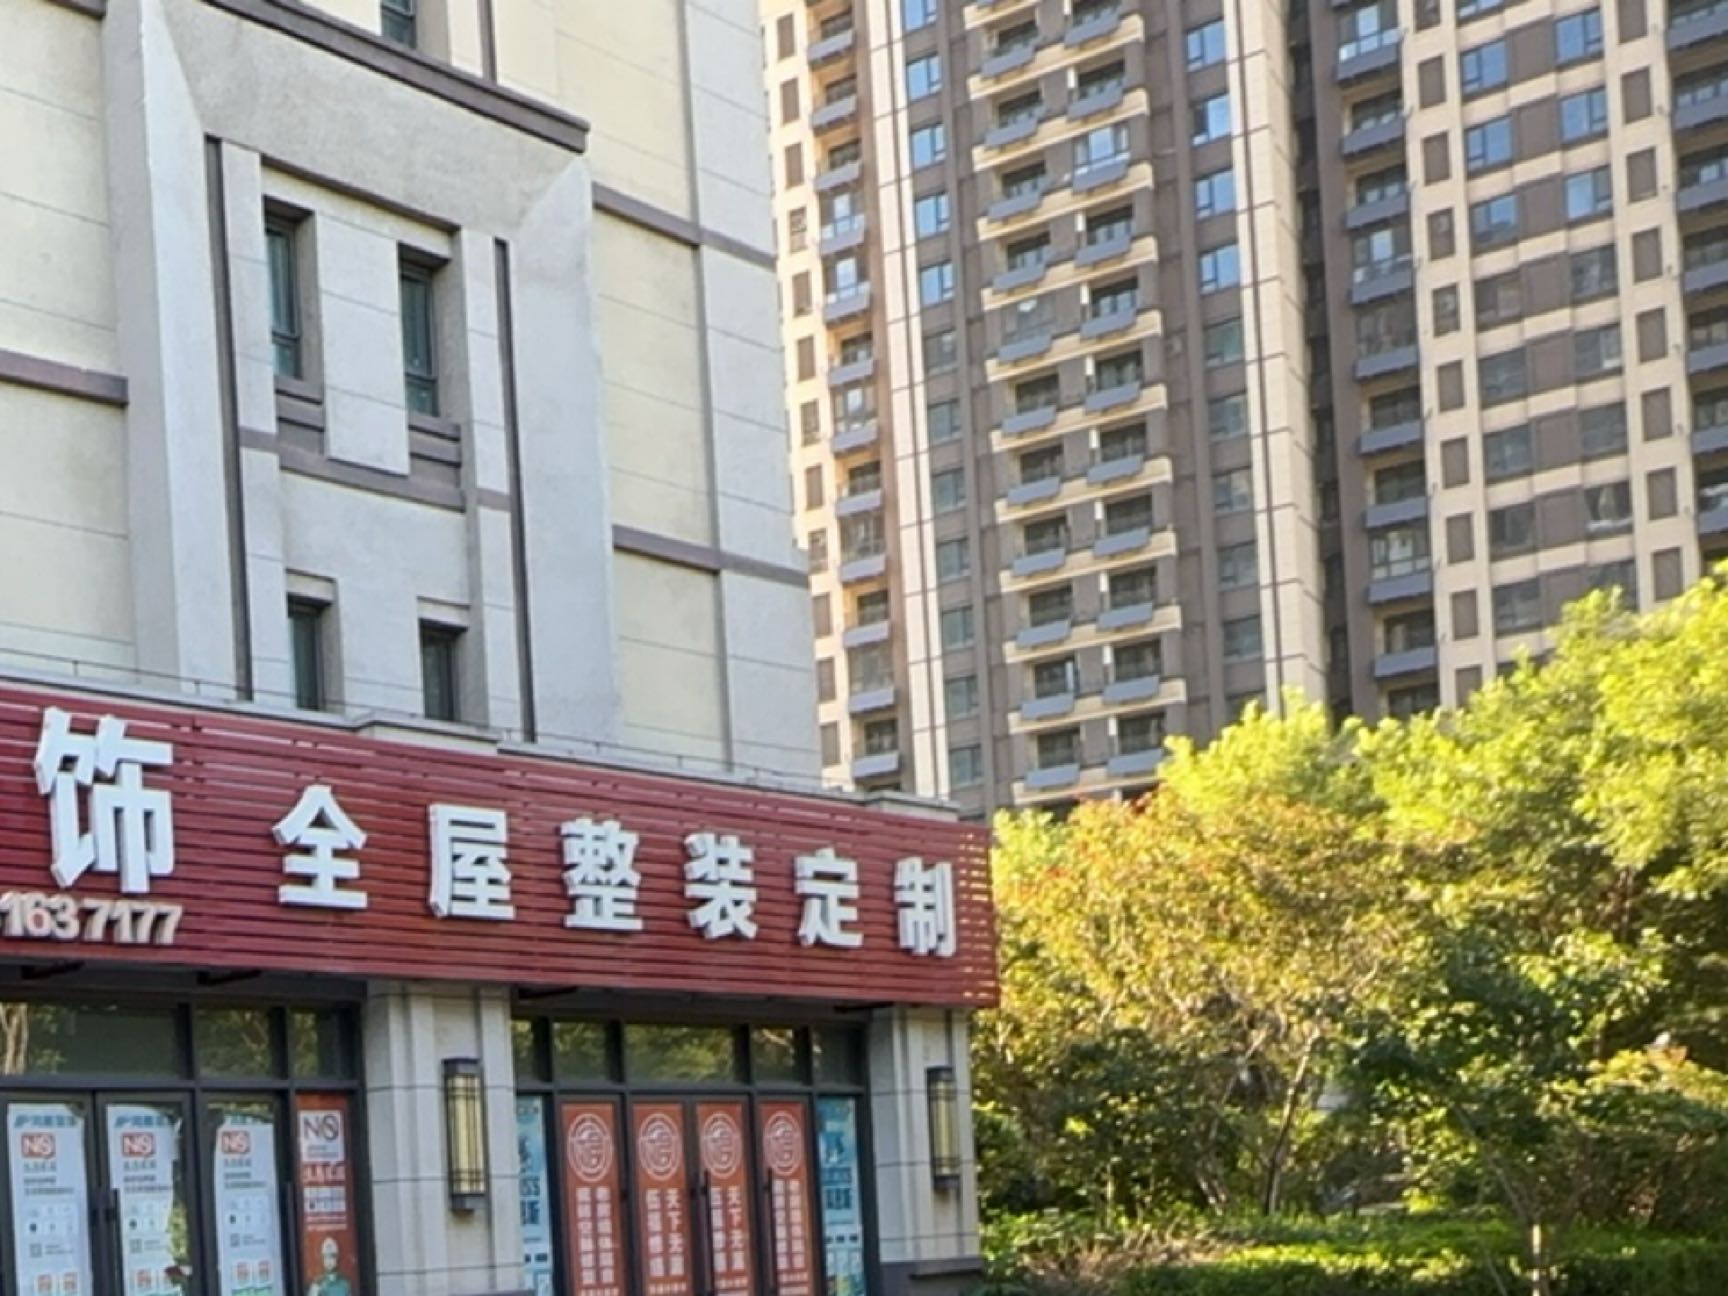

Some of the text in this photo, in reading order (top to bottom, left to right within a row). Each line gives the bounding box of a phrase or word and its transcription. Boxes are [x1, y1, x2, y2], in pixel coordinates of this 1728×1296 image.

[272, 784, 957, 958] 全屋整装定制
